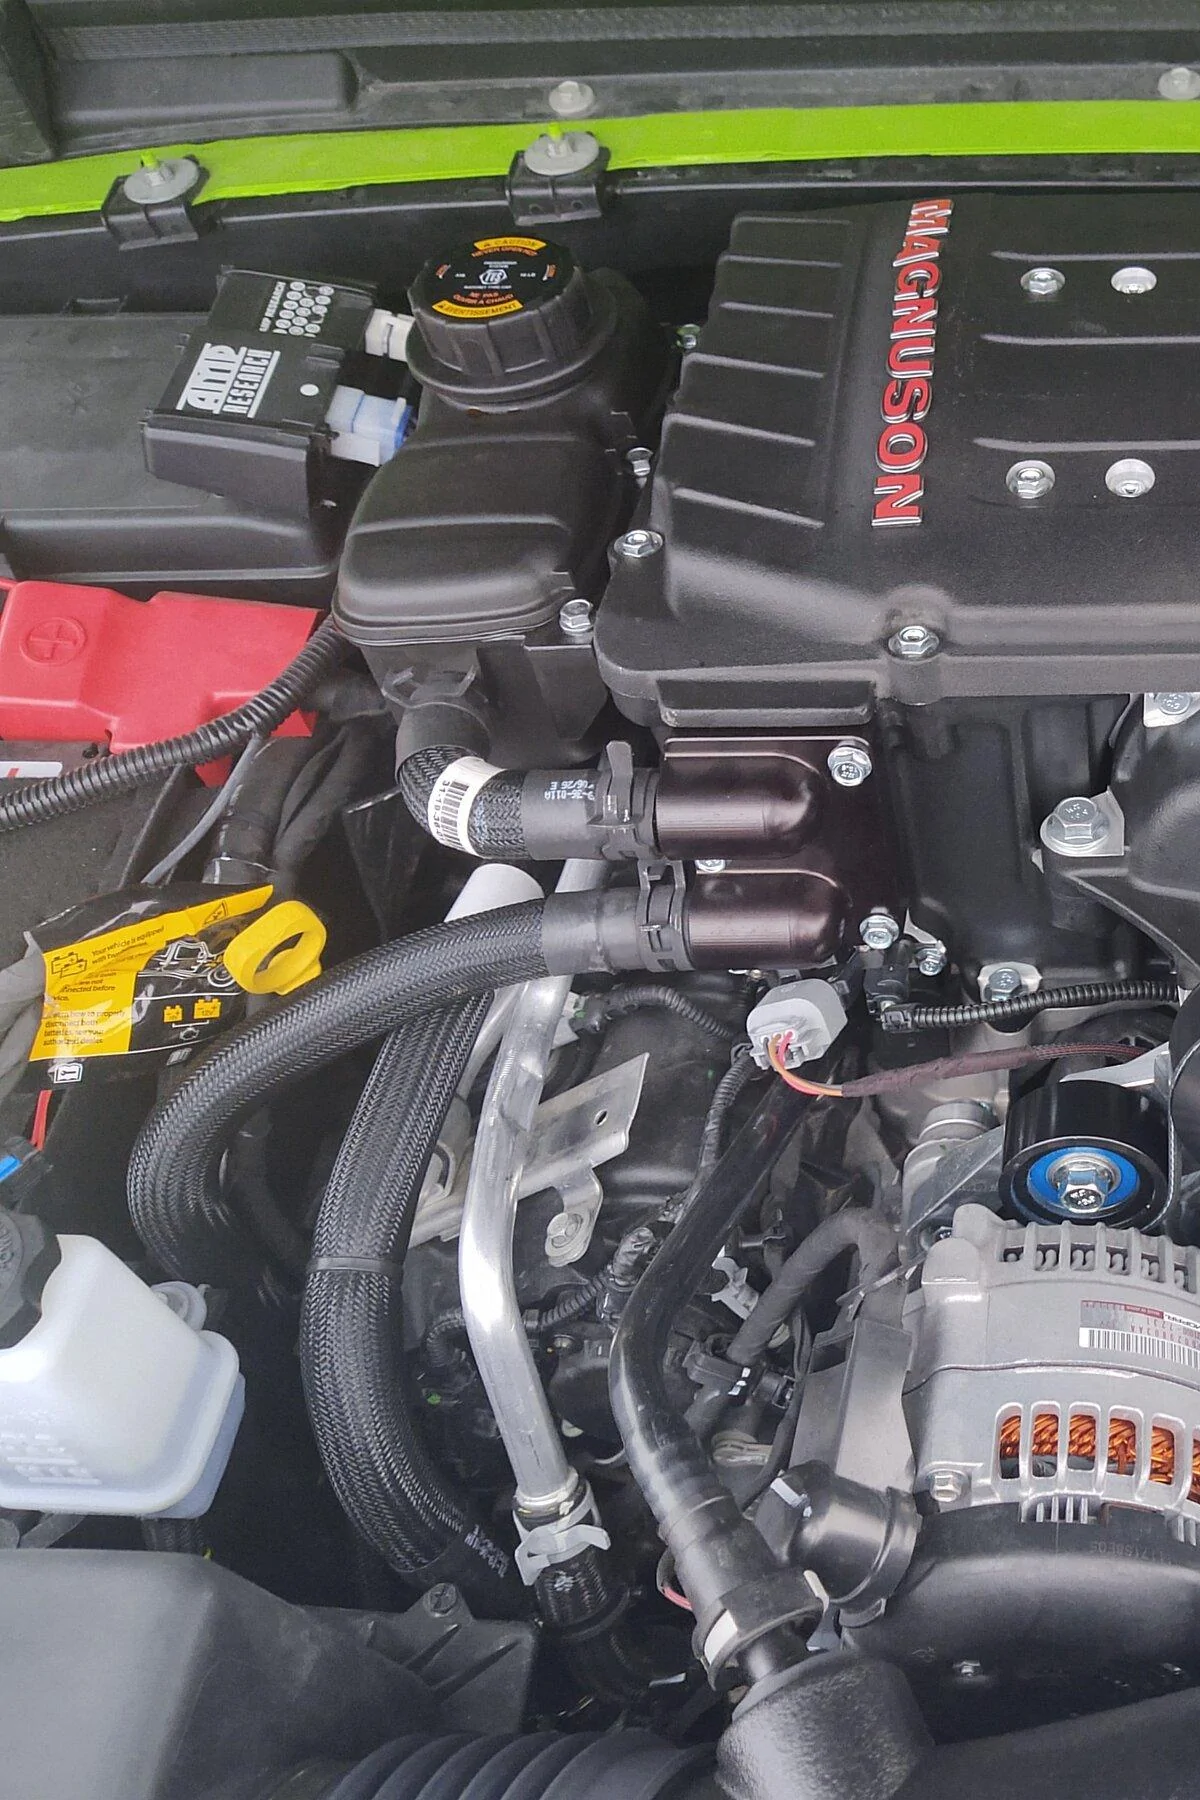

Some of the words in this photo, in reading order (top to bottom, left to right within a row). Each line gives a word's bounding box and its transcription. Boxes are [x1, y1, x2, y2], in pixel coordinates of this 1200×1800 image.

[178, 343, 247, 414] AMP
[222, 349, 273, 414] RESEARCH
[872, 198, 953, 527] MAGNUSON
